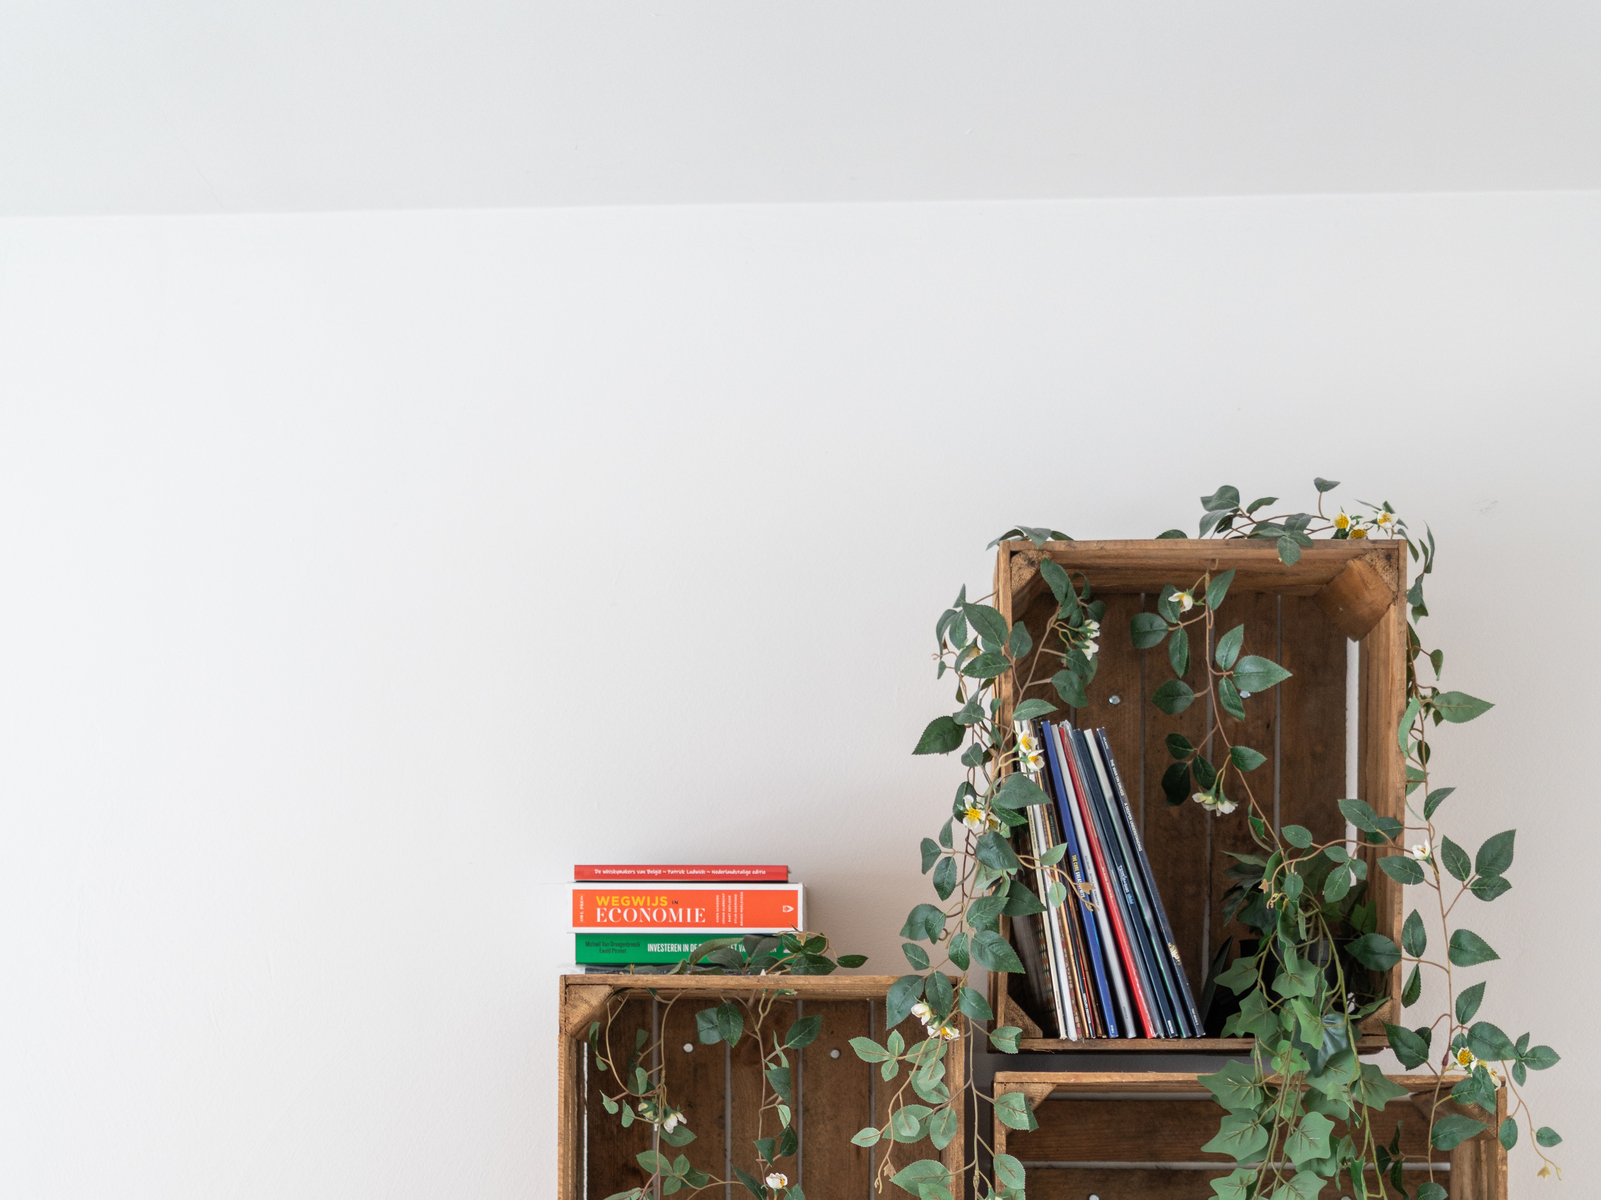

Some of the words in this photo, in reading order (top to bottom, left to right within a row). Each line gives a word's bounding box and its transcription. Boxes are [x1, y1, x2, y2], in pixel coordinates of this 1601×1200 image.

[596, 896, 668, 906] WEGWIJS
[596, 907, 706, 923] ECONOMIE
[647, 943, 682, 952] INVESTEREN
[683, 944, 689, 952] IN
[690, 944, 697, 952] DE
